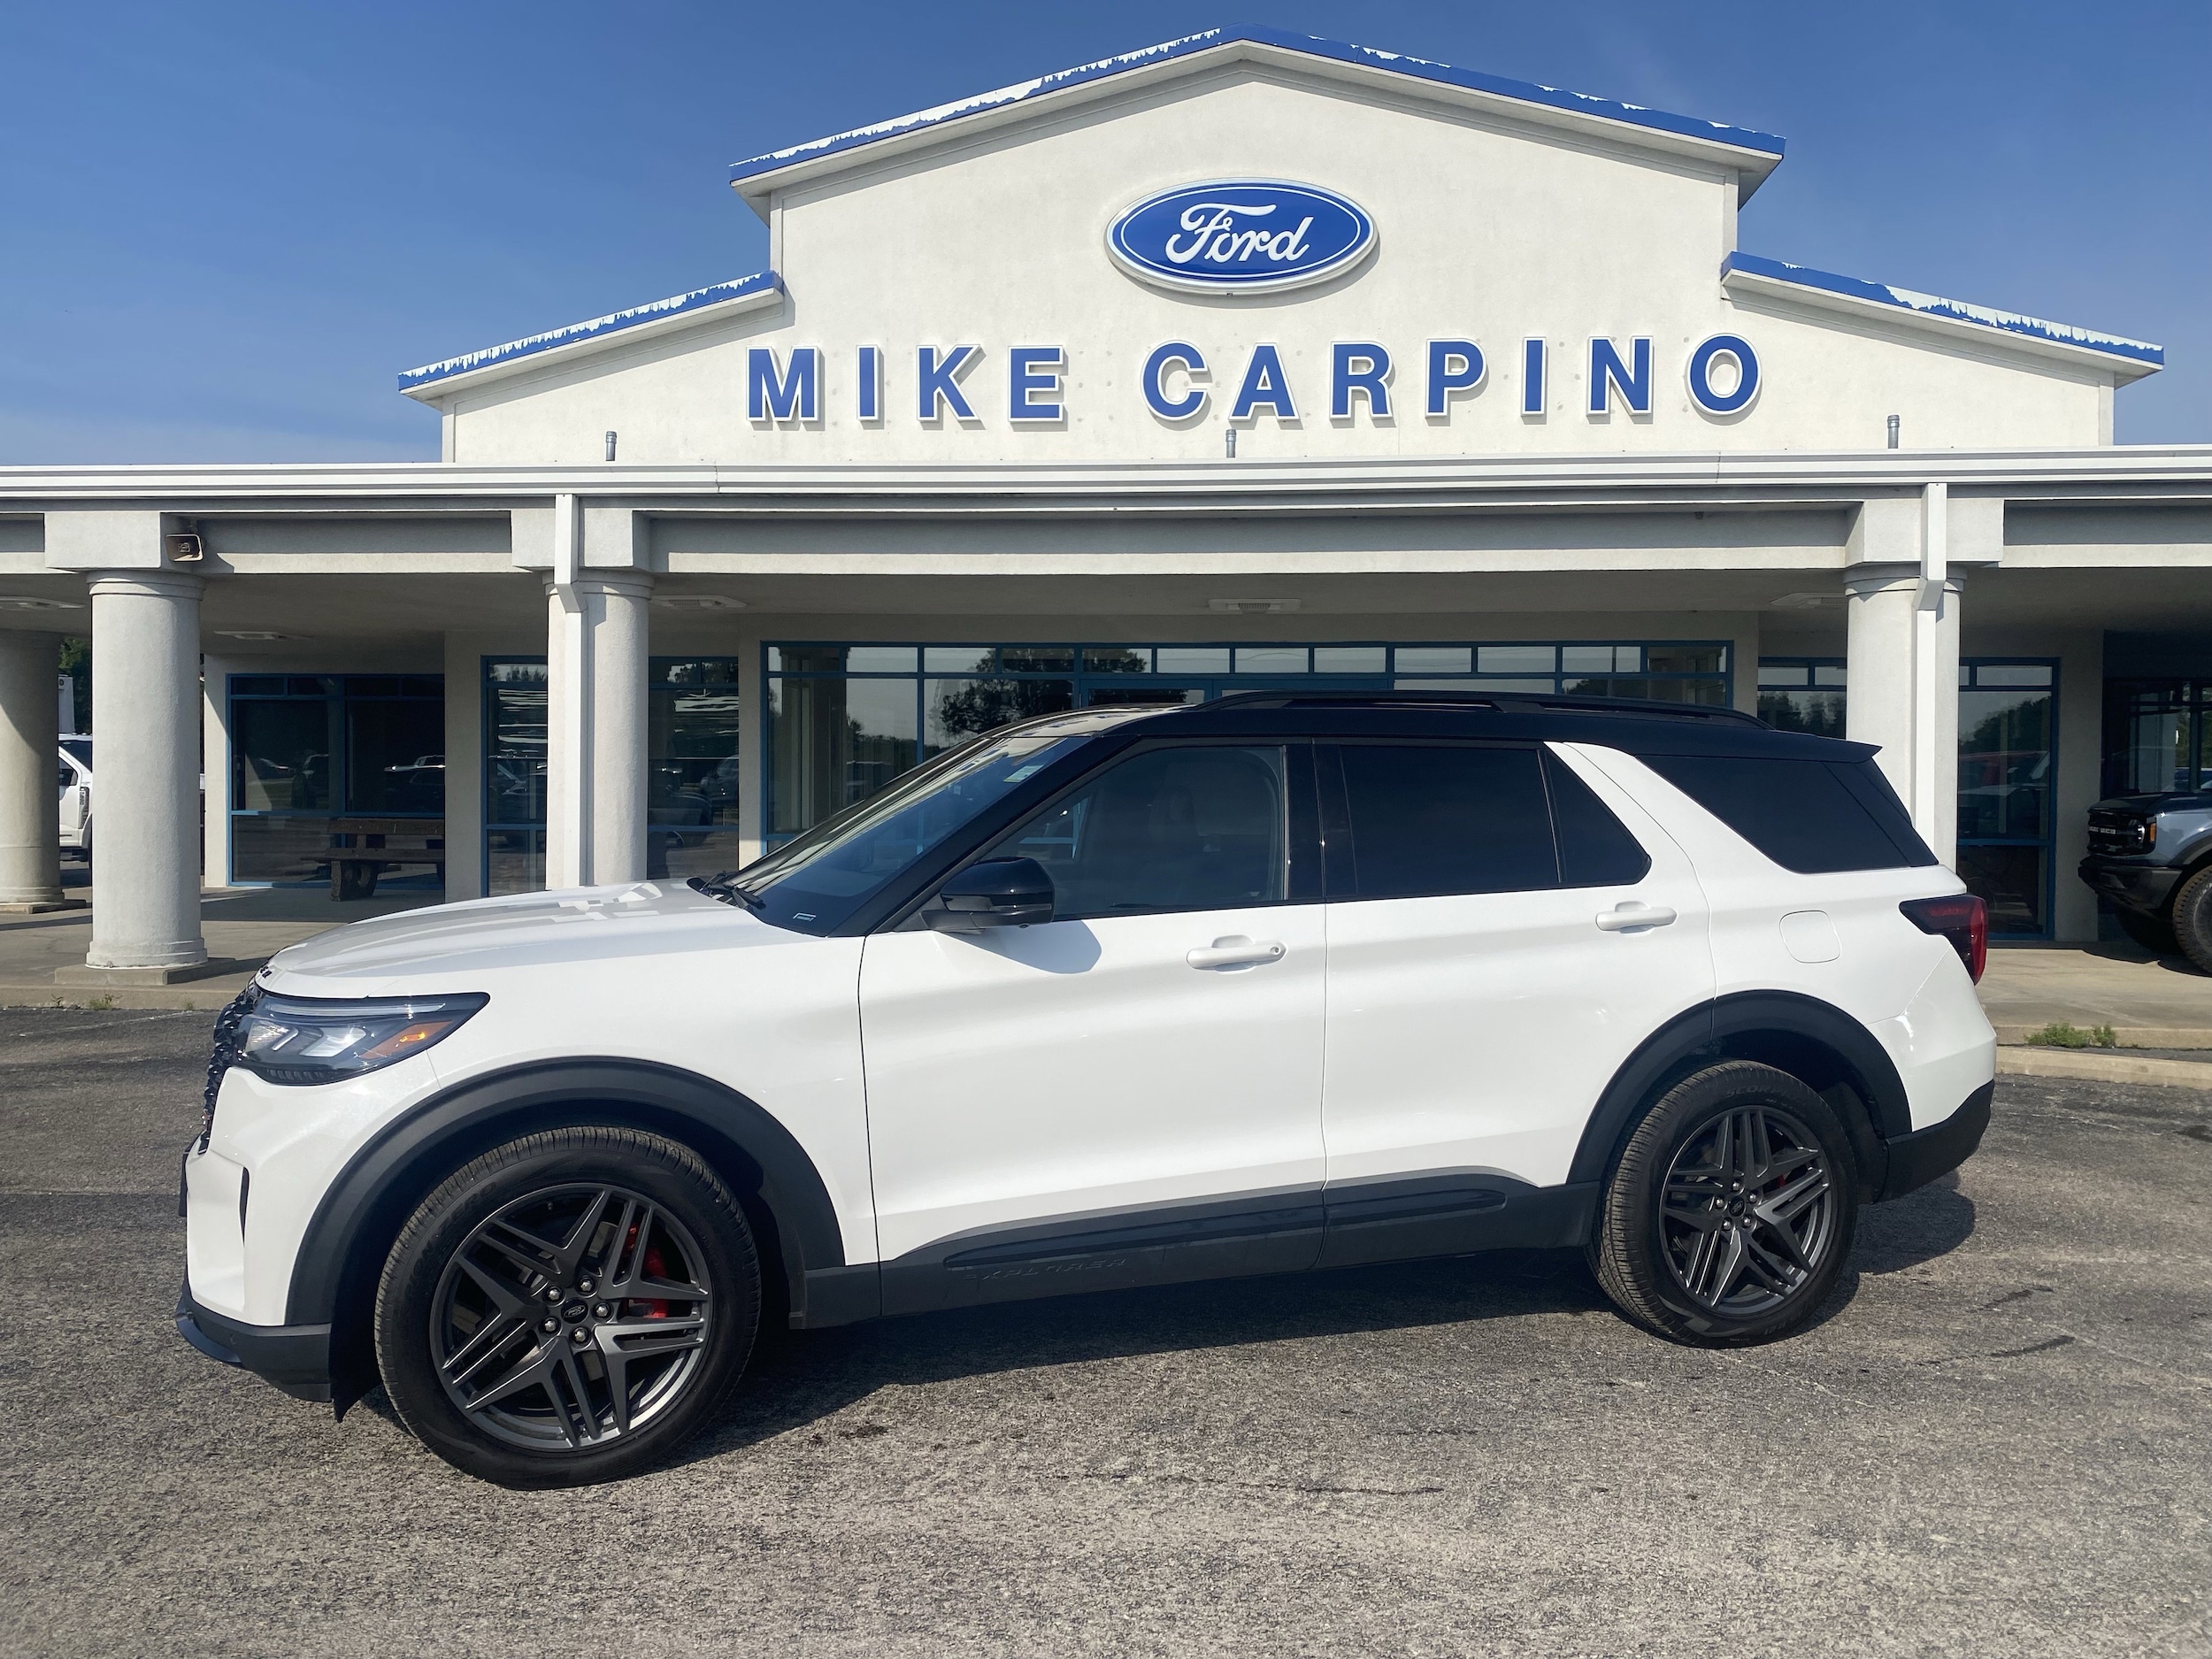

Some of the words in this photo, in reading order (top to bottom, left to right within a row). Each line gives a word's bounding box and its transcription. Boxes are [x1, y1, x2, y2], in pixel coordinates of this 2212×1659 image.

[1165, 203, 1314, 264] Ford
[746, 344, 1064, 423] MIKE
[1140, 332, 1763, 423] CARPINO
